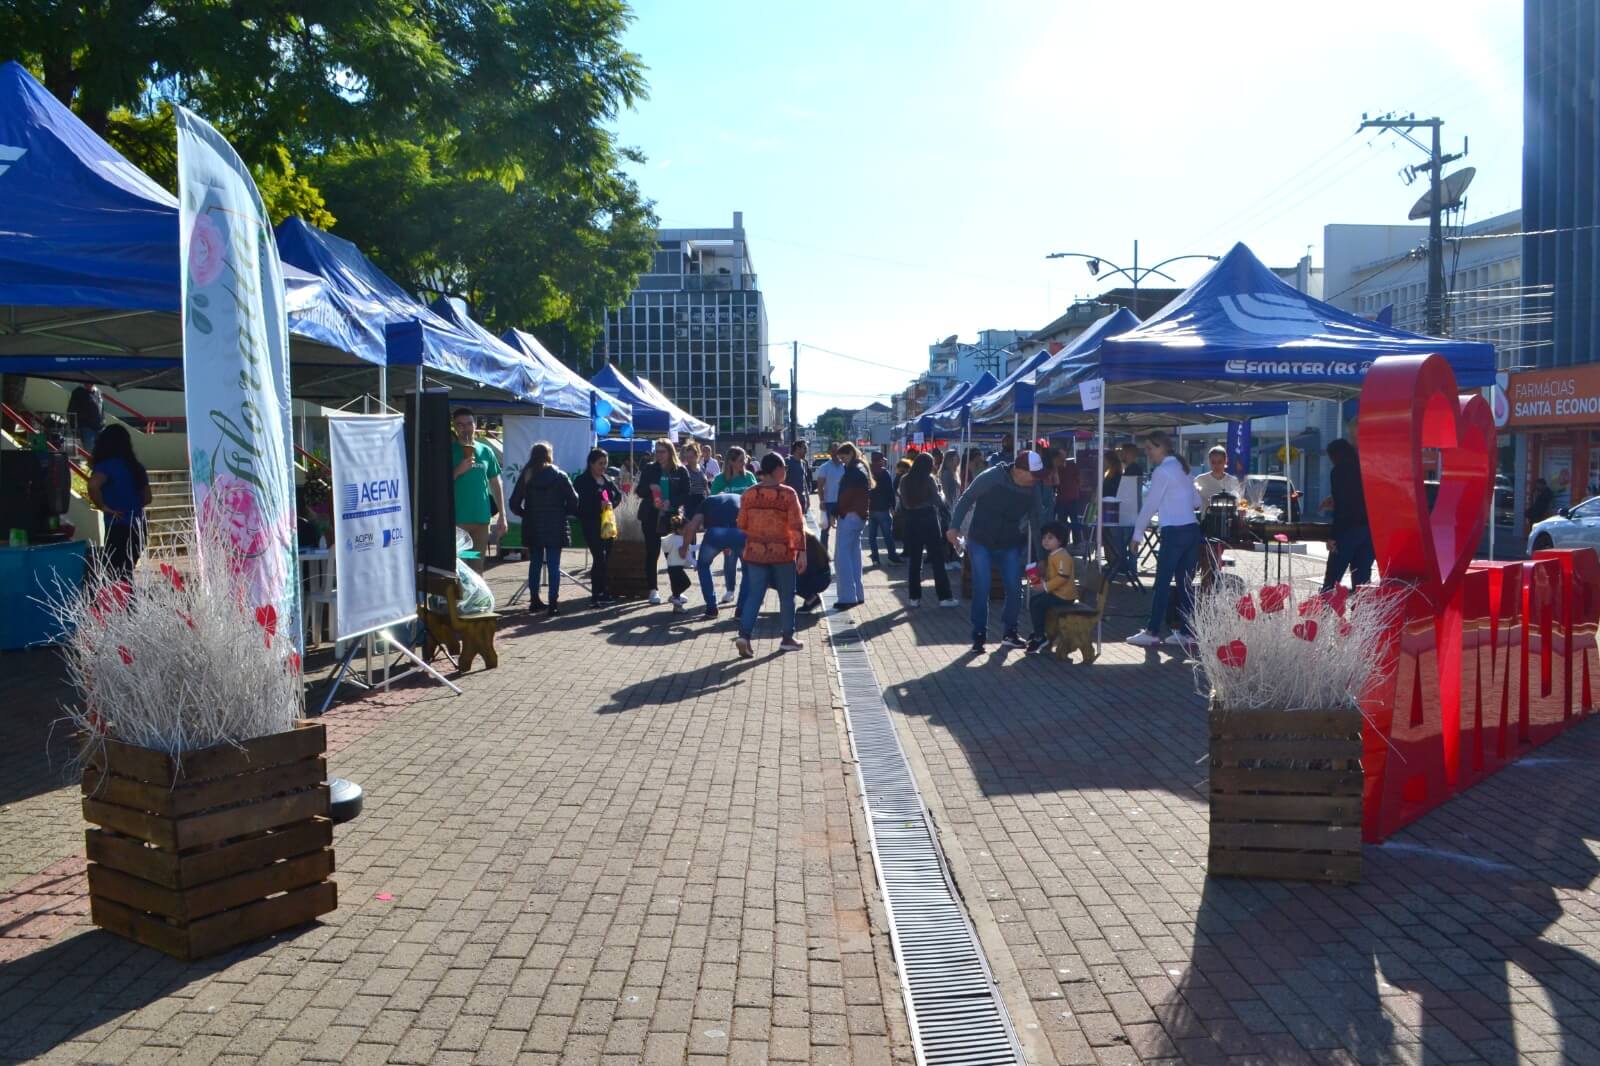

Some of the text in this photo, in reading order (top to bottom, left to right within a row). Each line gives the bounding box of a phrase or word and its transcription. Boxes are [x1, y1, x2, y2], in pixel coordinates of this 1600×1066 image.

[1515, 378, 1576, 399] FARMÁCIAS
[1514, 395, 1600, 418] SANTA ECONO
[361, 479, 399, 502] AEFW
